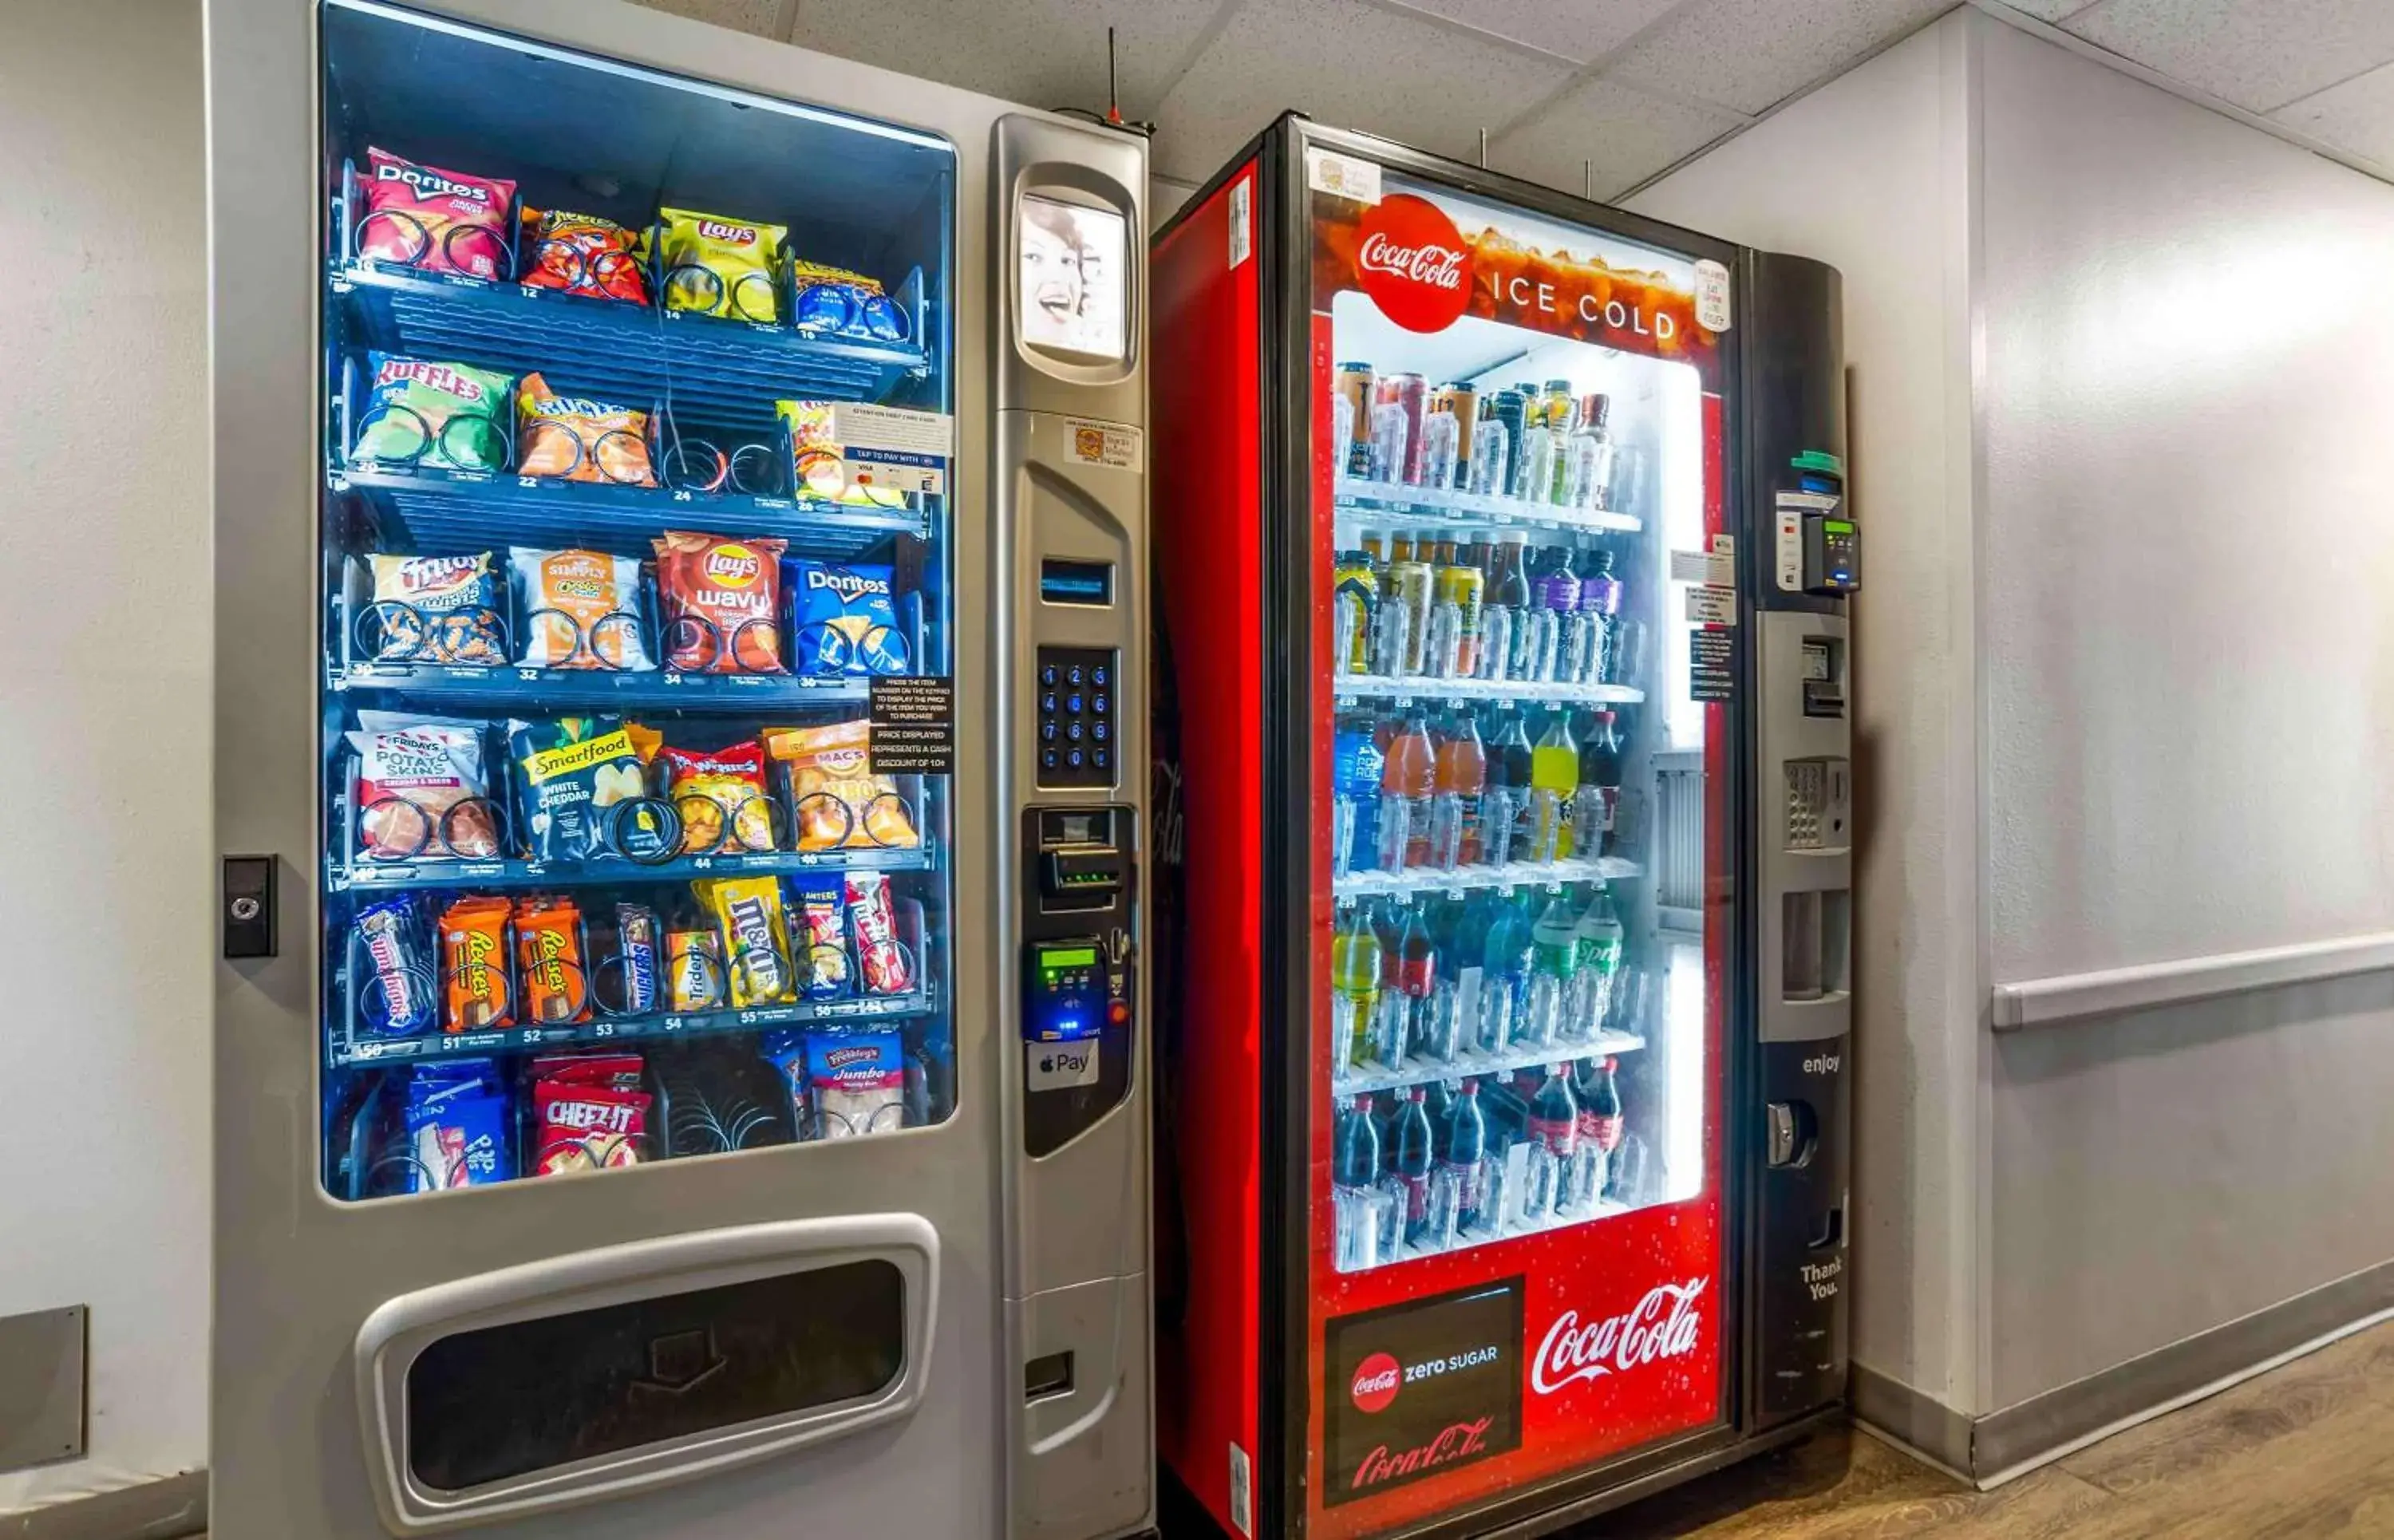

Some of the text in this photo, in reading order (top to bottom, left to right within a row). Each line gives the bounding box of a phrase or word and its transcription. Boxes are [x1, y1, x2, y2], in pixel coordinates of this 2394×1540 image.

[377, 164, 487, 200] Doritos
[1360, 232, 1468, 290] Coca-Cola
[521, 286, 537, 298] 12
[1493, 271, 1674, 339] ICE COLD
[665, 310, 681, 320] 14
[375, 361, 483, 401] RUFFLES
[519, 476, 537, 488] 22
[674, 491, 691, 501] 24
[808, 570, 889, 595] Doritos
[520, 669, 538, 680] 32
[665, 673, 681, 684] 34
[1047, 669, 1104, 684] 1 2 3
[1046, 697, 1054, 709] 4
[1096, 697, 1104, 711] 6
[878, 730, 945, 740] PRICE DISPLAYED
[1046, 725, 1104, 740] 7 8 9
[393, 736, 440, 751] FRIDAYS
[376, 749, 449, 767] POTATO
[535, 736, 627, 776] Smartfood
[1073, 752, 1080, 765] 0
[386, 764, 446, 776] SKINS
[543, 781, 580, 795] WHITE
[539, 790, 591, 809] CHEDDAR
[694, 859, 712, 869] 44
[804, 891, 838, 901] ANTERS
[468, 930, 494, 998] Reese's
[539, 929, 567, 993] Reese's
[689, 946, 703, 1002] Trident
[665, 1018, 681, 1029] 54
[741, 1012, 757, 1023] 55
[523, 1030, 541, 1042] 52
[596, 1024, 613, 1036] 53
[443, 1037, 459, 1049] 51
[1057, 1053, 1088, 1073] Pay
[1803, 1054, 1840, 1074] enjoy
[833, 1066, 886, 1081] Jumbo
[547, 1100, 635, 1132] CHEEZ-IT
[1800, 1256, 1843, 1284] Thank
[1810, 1281, 1838, 1301] You.
[1531, 1274, 1710, 1396] Coca-Cola
[1404, 1345, 1498, 1384] zero SUGAR
